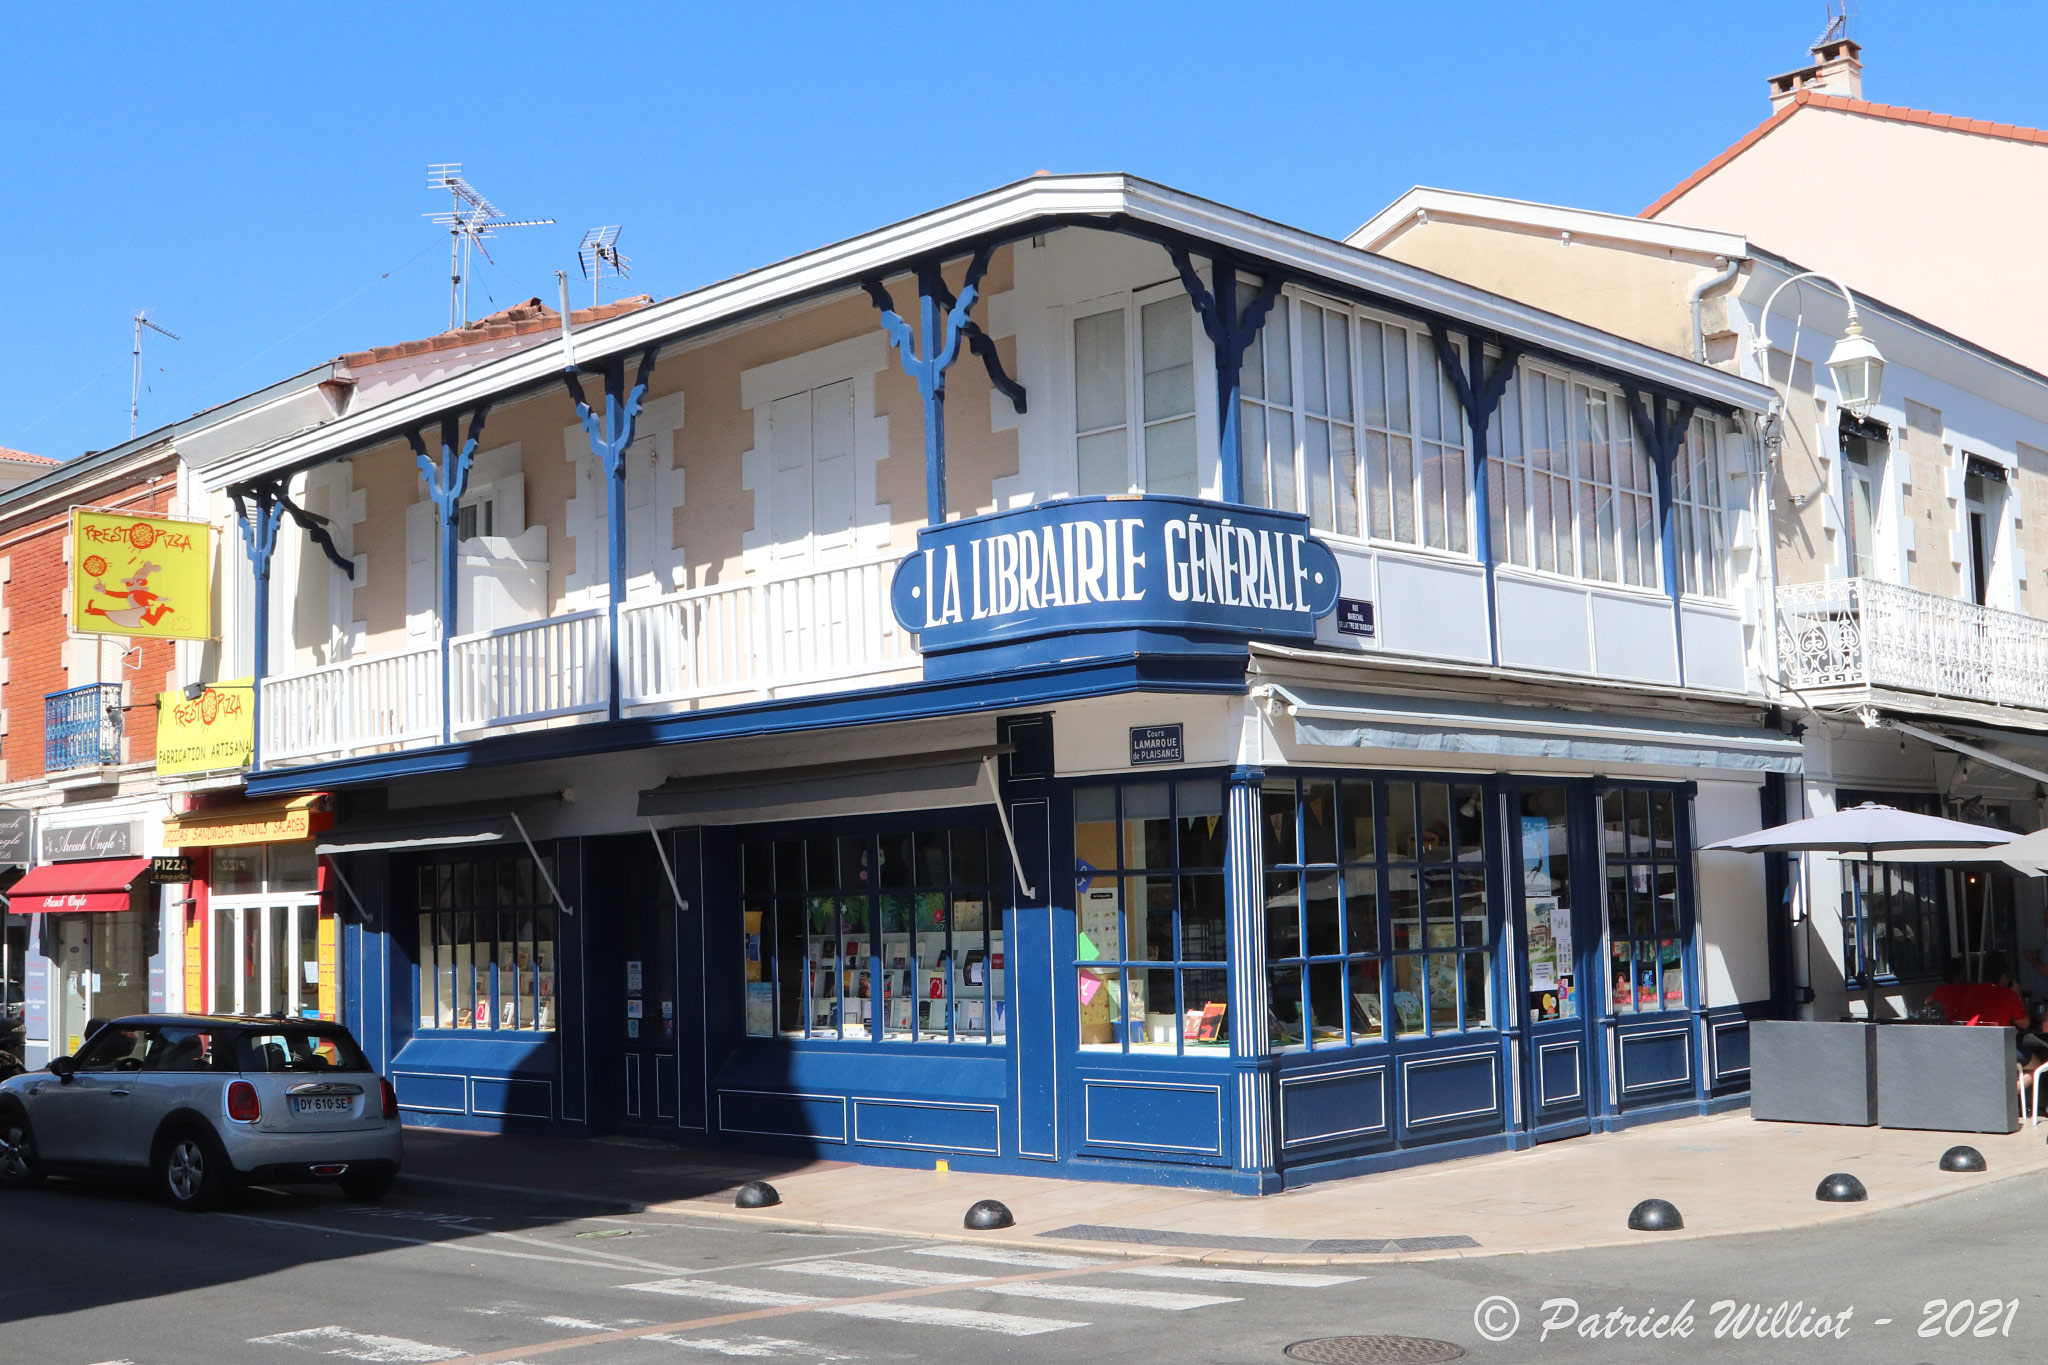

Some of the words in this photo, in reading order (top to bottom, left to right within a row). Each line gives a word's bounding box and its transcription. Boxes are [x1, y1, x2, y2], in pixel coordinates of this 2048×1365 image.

[924, 545, 964, 628] LA
[970, 518, 1146, 620] LIBRAIRIE
[1164, 514, 1311, 613] GÉNÉRALE
[1146, 730, 1165, 738] Cours
[1134, 737, 1177, 750] LAMARQUE
[159, 746, 206, 765] FABRICATION
[1132, 751, 1140, 760] de
[1141, 748, 1180, 759] PLAISANCE
[273, 818, 305, 833] SALADES
[154, 859, 188, 871] PIZZA
[301, 1098, 347, 1110] DY-610-SE
